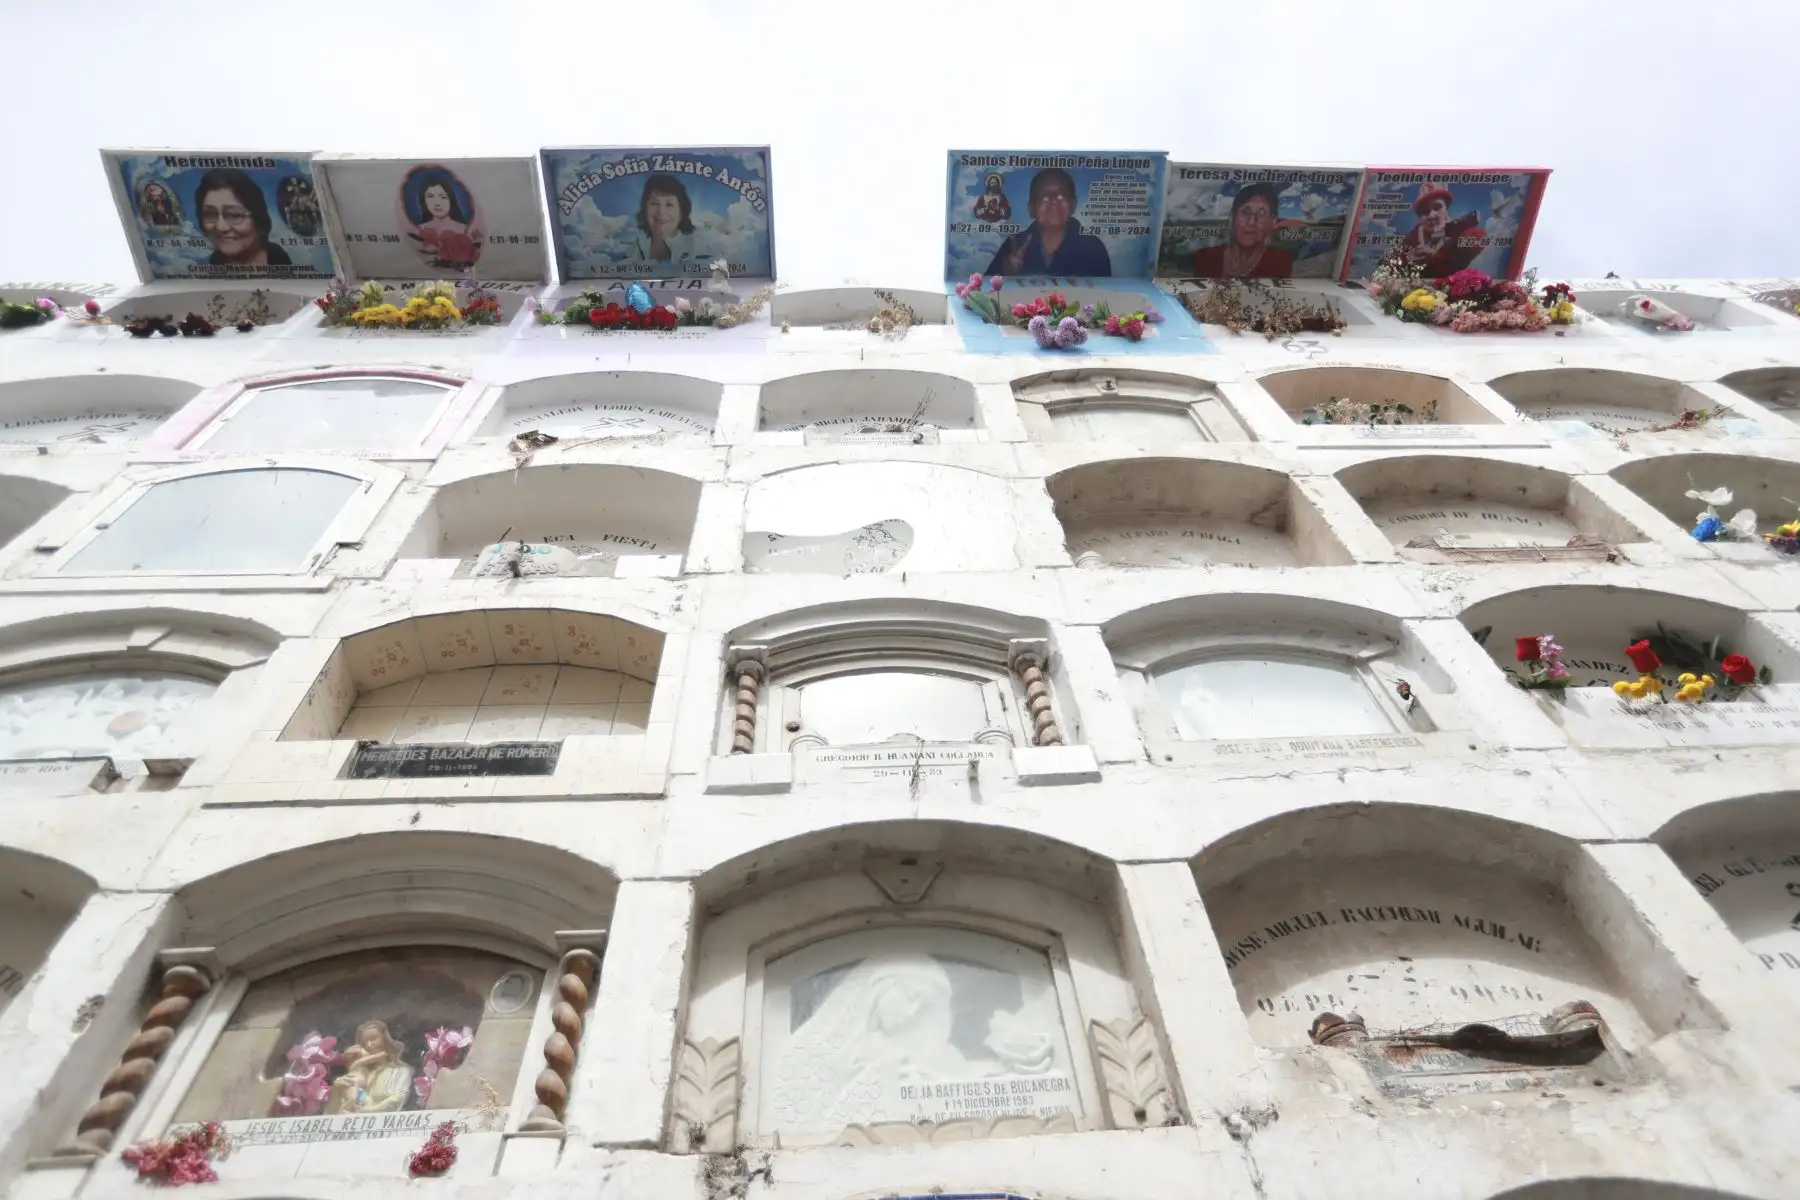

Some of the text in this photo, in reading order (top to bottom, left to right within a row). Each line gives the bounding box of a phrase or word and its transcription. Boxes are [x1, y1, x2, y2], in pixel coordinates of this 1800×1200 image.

[164, 155, 276, 168] Hermelinda
[961, 154, 1151, 170] Santos Florentino Peña Luque
[1179, 168, 1229, 180] Teresa
[1232, 169, 1285, 182] Sinche
[1461, 174, 1510, 185] Quispe
[559, 171, 602, 215] Alicia
[652, 155, 713, 178] Zárate
[715, 167, 767, 213] Antón
[608, 279, 703, 290] AICIA
[594, 403, 644, 412] FLORES
[1289, 740, 1343, 753] QUINTANA
[361, 748, 428, 762] MERCEDES
[430, 747, 489, 761] BAZALAR
[490, 748, 506, 760] DE
[1265, 911, 1333, 940] MIGUEL
[994, 1083, 1007, 1095] DE
[1010, 1078, 1071, 1094] BOCANEGRA
[964, 1097, 1011, 1109] DICIEMBRE
[1013, 1096, 1034, 1106] 1983
[245, 1112, 431, 1134] JESUS ISABEL RETO VARGAS
